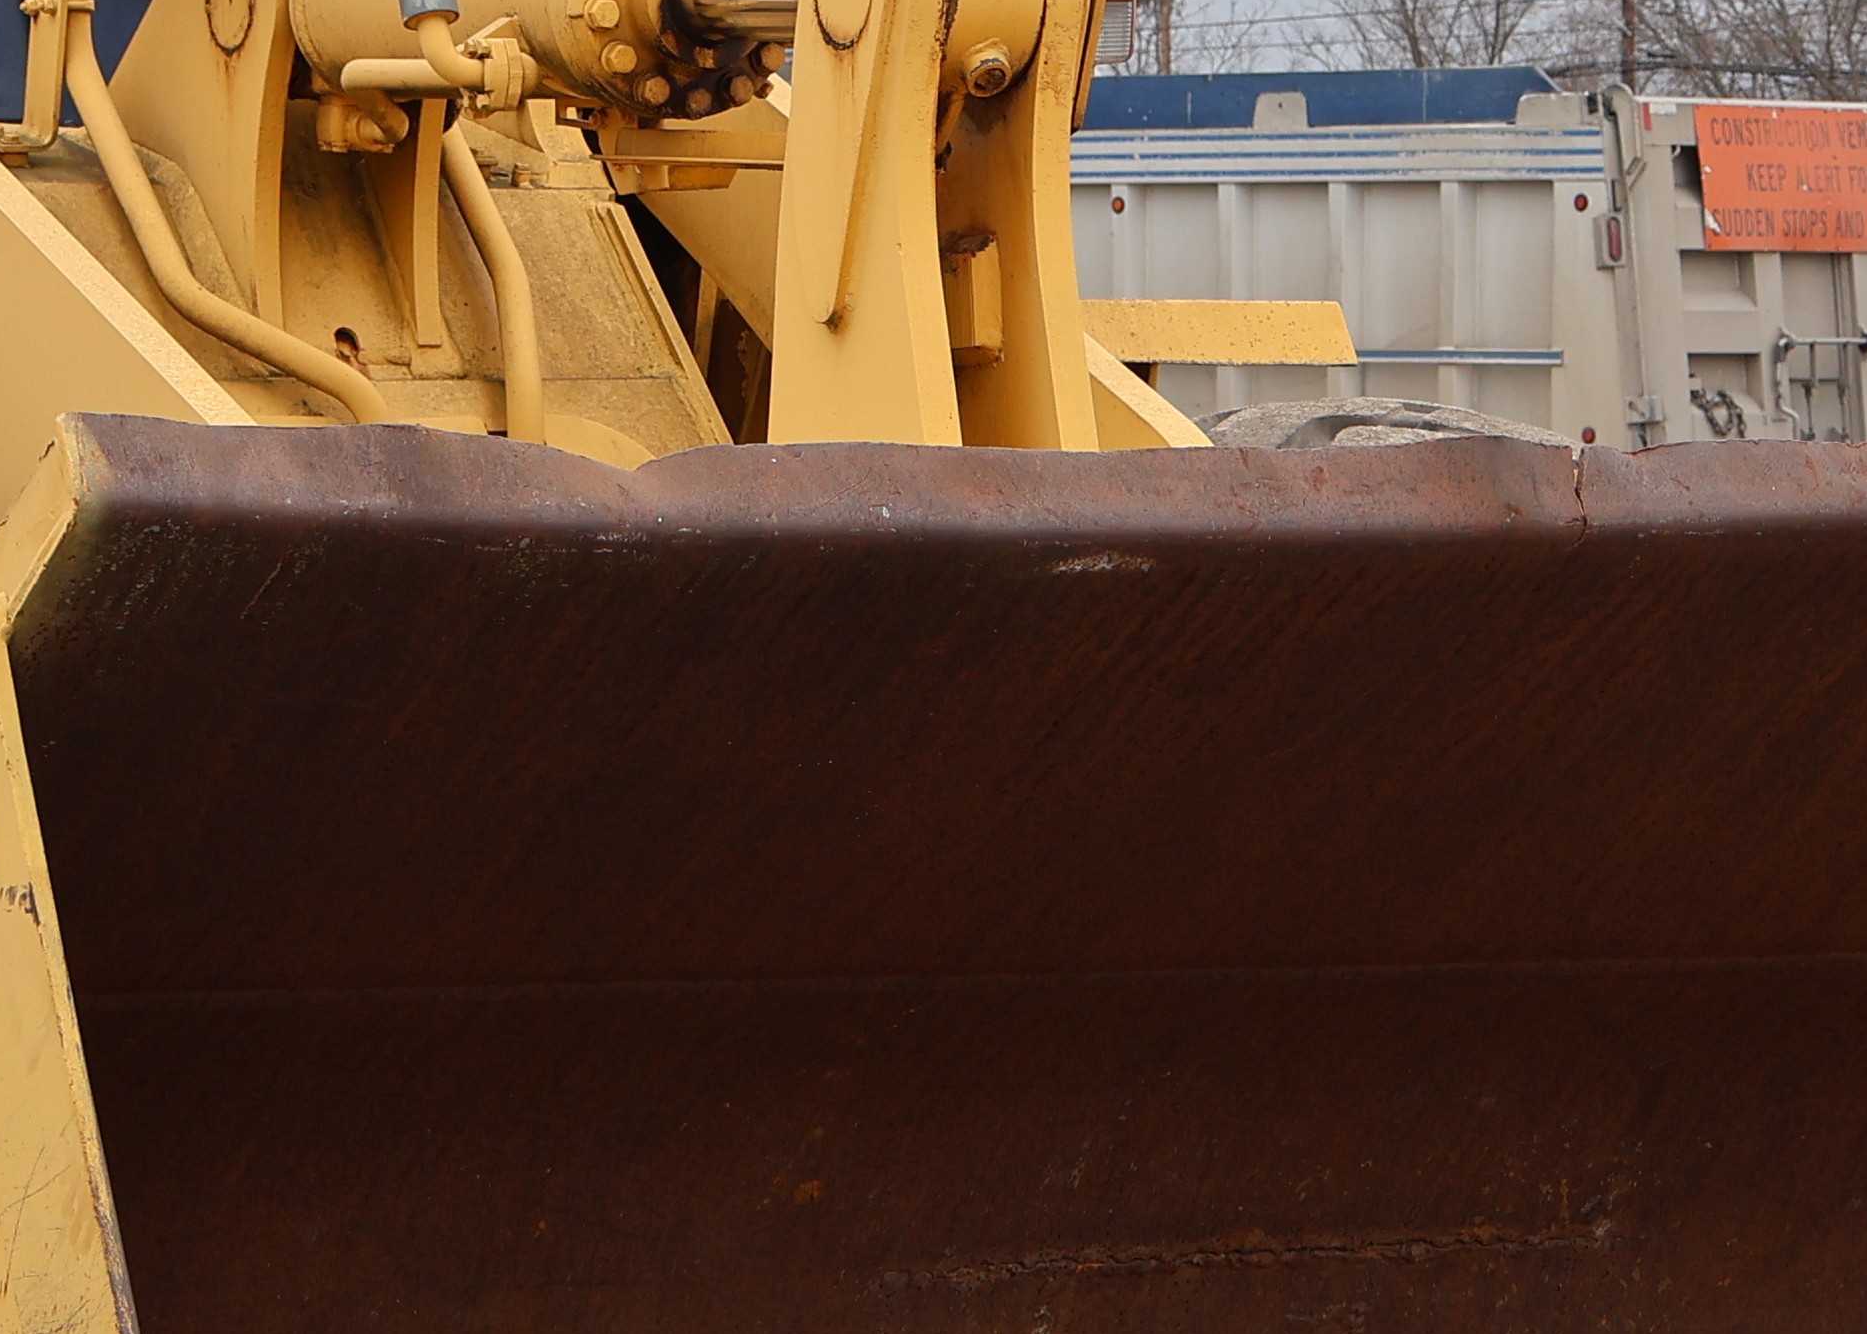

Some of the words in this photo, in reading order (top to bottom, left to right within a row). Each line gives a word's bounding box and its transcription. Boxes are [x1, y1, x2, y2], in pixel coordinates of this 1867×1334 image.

[1710, 117, 1831, 150] CONSTRUCTION
[1746, 163, 1787, 191] KEEP
[1796, 164, 1841, 193] ALERT
[1711, 207, 1775, 237] SUDDEN
[1782, 209, 1828, 238] STOPS
[1834, 210, 1865, 239] AND
